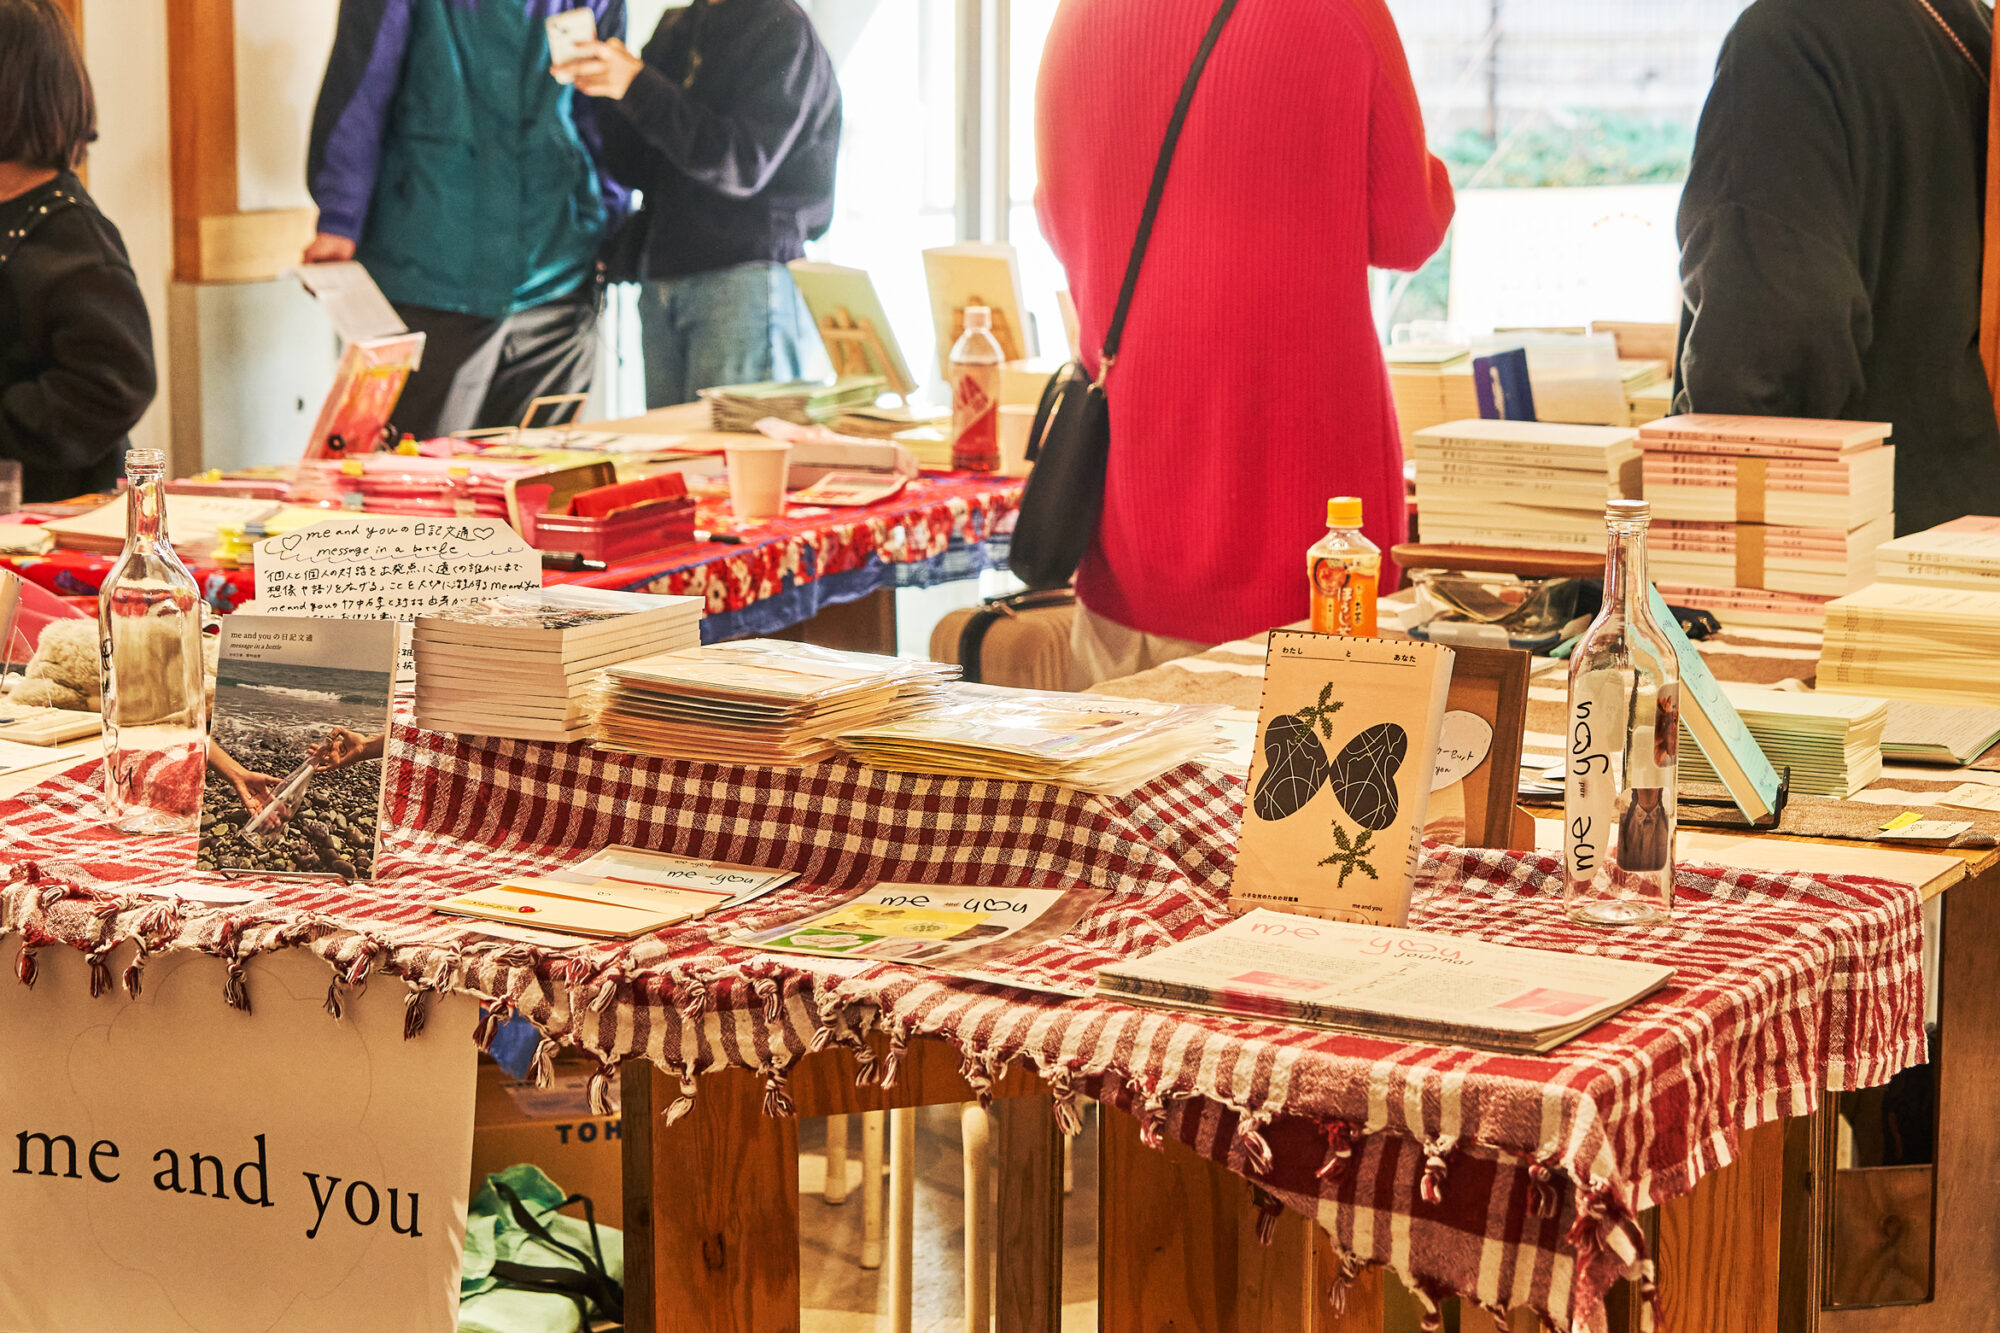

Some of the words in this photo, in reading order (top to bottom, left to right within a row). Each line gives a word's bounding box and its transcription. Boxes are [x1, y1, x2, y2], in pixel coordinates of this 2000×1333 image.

[306, 528, 331, 541] me
[336, 525, 360, 536] and
[317, 547, 369, 557] message
[376, 546, 387, 554] in
[413, 542, 458, 555] bottle
[243, 631, 257, 640] and
[258, 633, 271, 641] you
[1282, 646, 1303, 655] わたし
[1345, 650, 1351, 658] と
[1393, 654, 1416, 663] あなた
[1571, 816, 1595, 871] me
[667, 870, 697, 879] me
[879, 895, 930, 907] me
[1250, 922, 1321, 941] me
[12, 1129, 121, 1184] me
[152, 1133, 275, 1208] and
[302, 1171, 423, 1240] you
